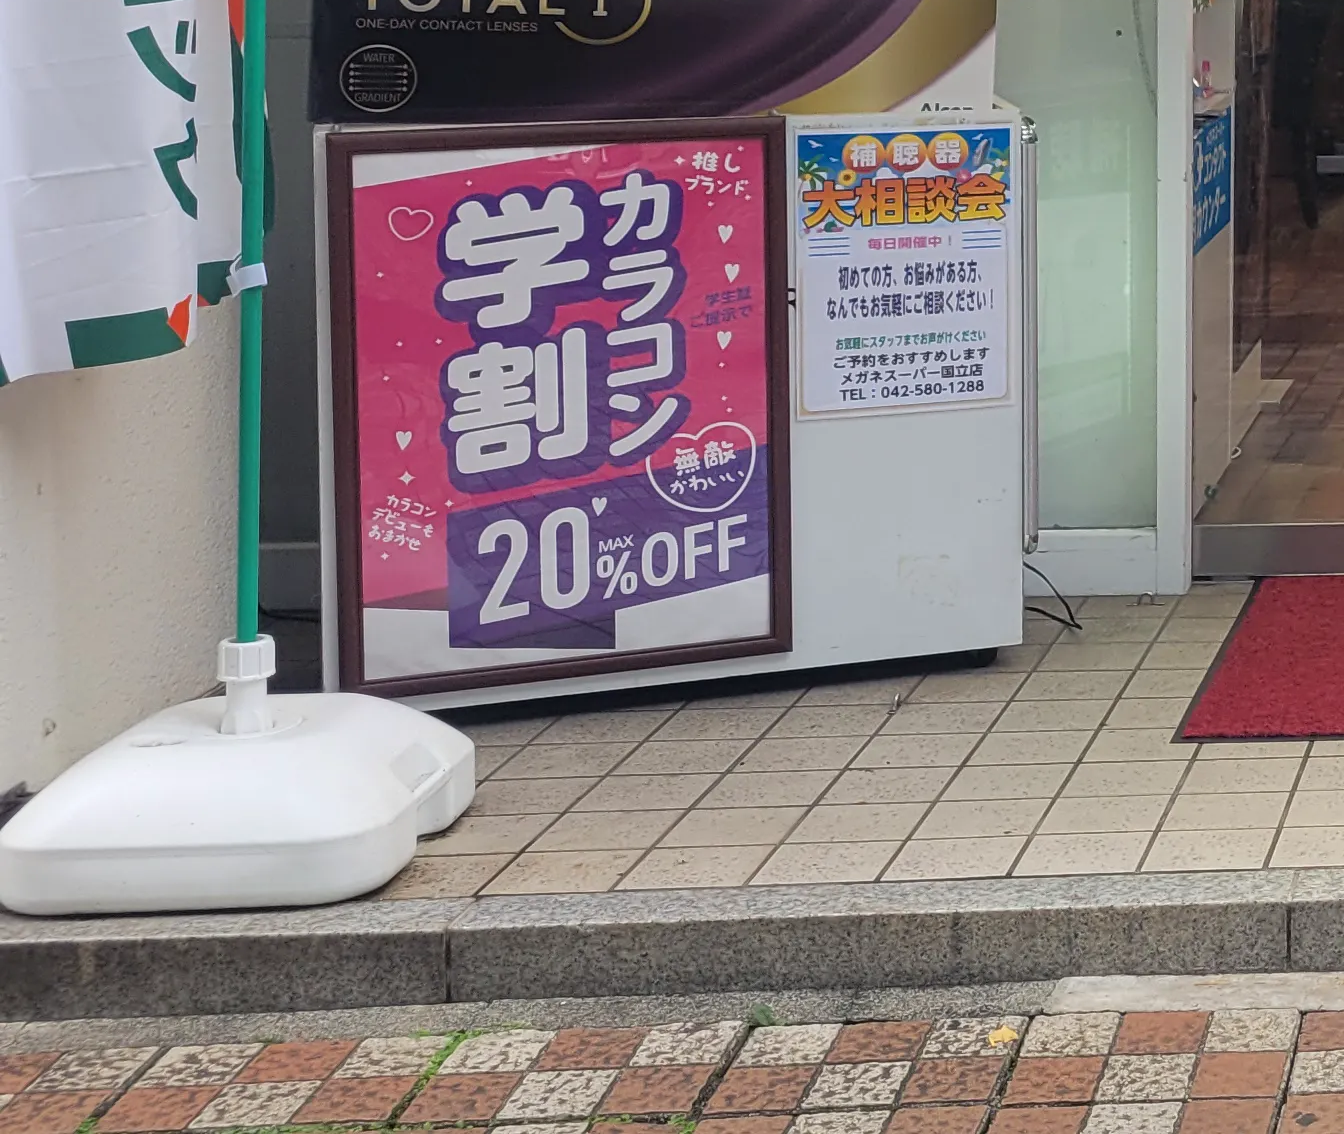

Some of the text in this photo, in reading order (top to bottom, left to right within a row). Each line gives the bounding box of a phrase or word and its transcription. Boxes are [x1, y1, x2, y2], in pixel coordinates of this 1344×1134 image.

[355, 17, 539, 33] ONE-DAY CONTACT LENSES
[362, 52, 396, 64] WATER
[354, 92, 402, 103] GRADIENT
[691, 150, 741, 173] 推し
[849, 139, 961, 168] 補聴器
[684, 173, 750, 196] ブランド
[802, 172, 1008, 229] 大相談会
[600, 171, 679, 458] カラコン
[441, 185, 590, 475] 学割
[833, 346, 990, 369] ご予約をおすすめします
[840, 364, 984, 386] メガネスーパー国立店
[673, 440, 738, 475] 無敵
[669, 468, 746, 497] かわいい
[385, 492, 438, 519] カラコン
[371, 507, 434, 538] デビューも
[367, 524, 422, 552] おまかせ
[598, 533, 636, 552] MAX
